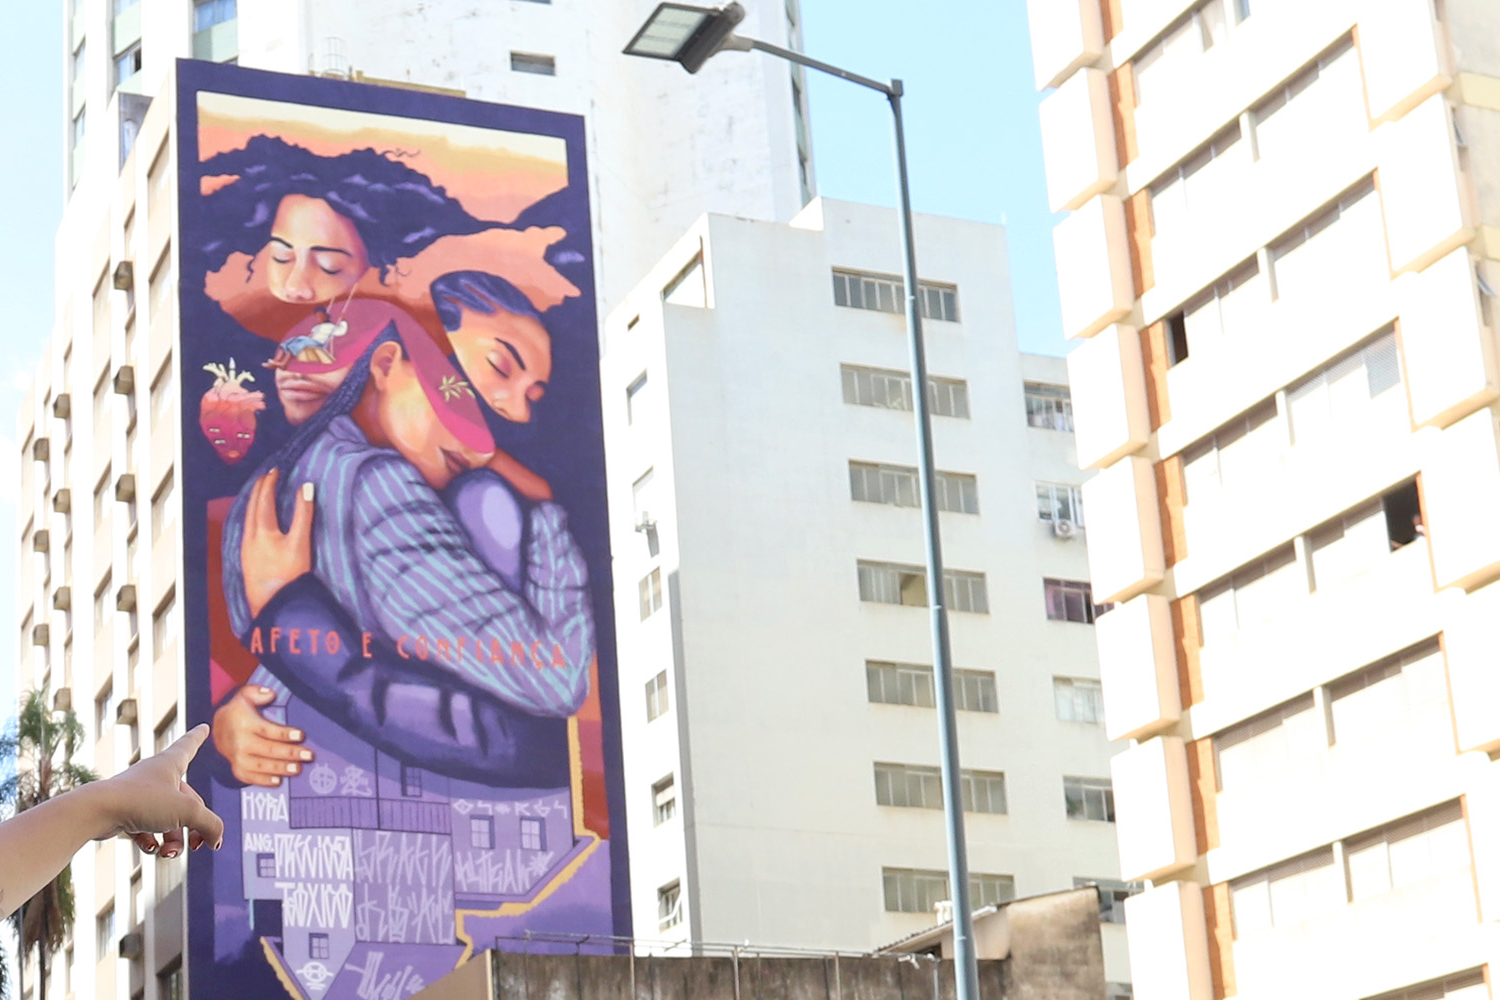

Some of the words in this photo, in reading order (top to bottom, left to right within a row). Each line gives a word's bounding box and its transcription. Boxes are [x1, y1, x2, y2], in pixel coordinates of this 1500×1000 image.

[251, 627, 340, 654] AFETO
[361, 632, 373, 658] E
[396, 635, 566, 670] CONFIANÇA
